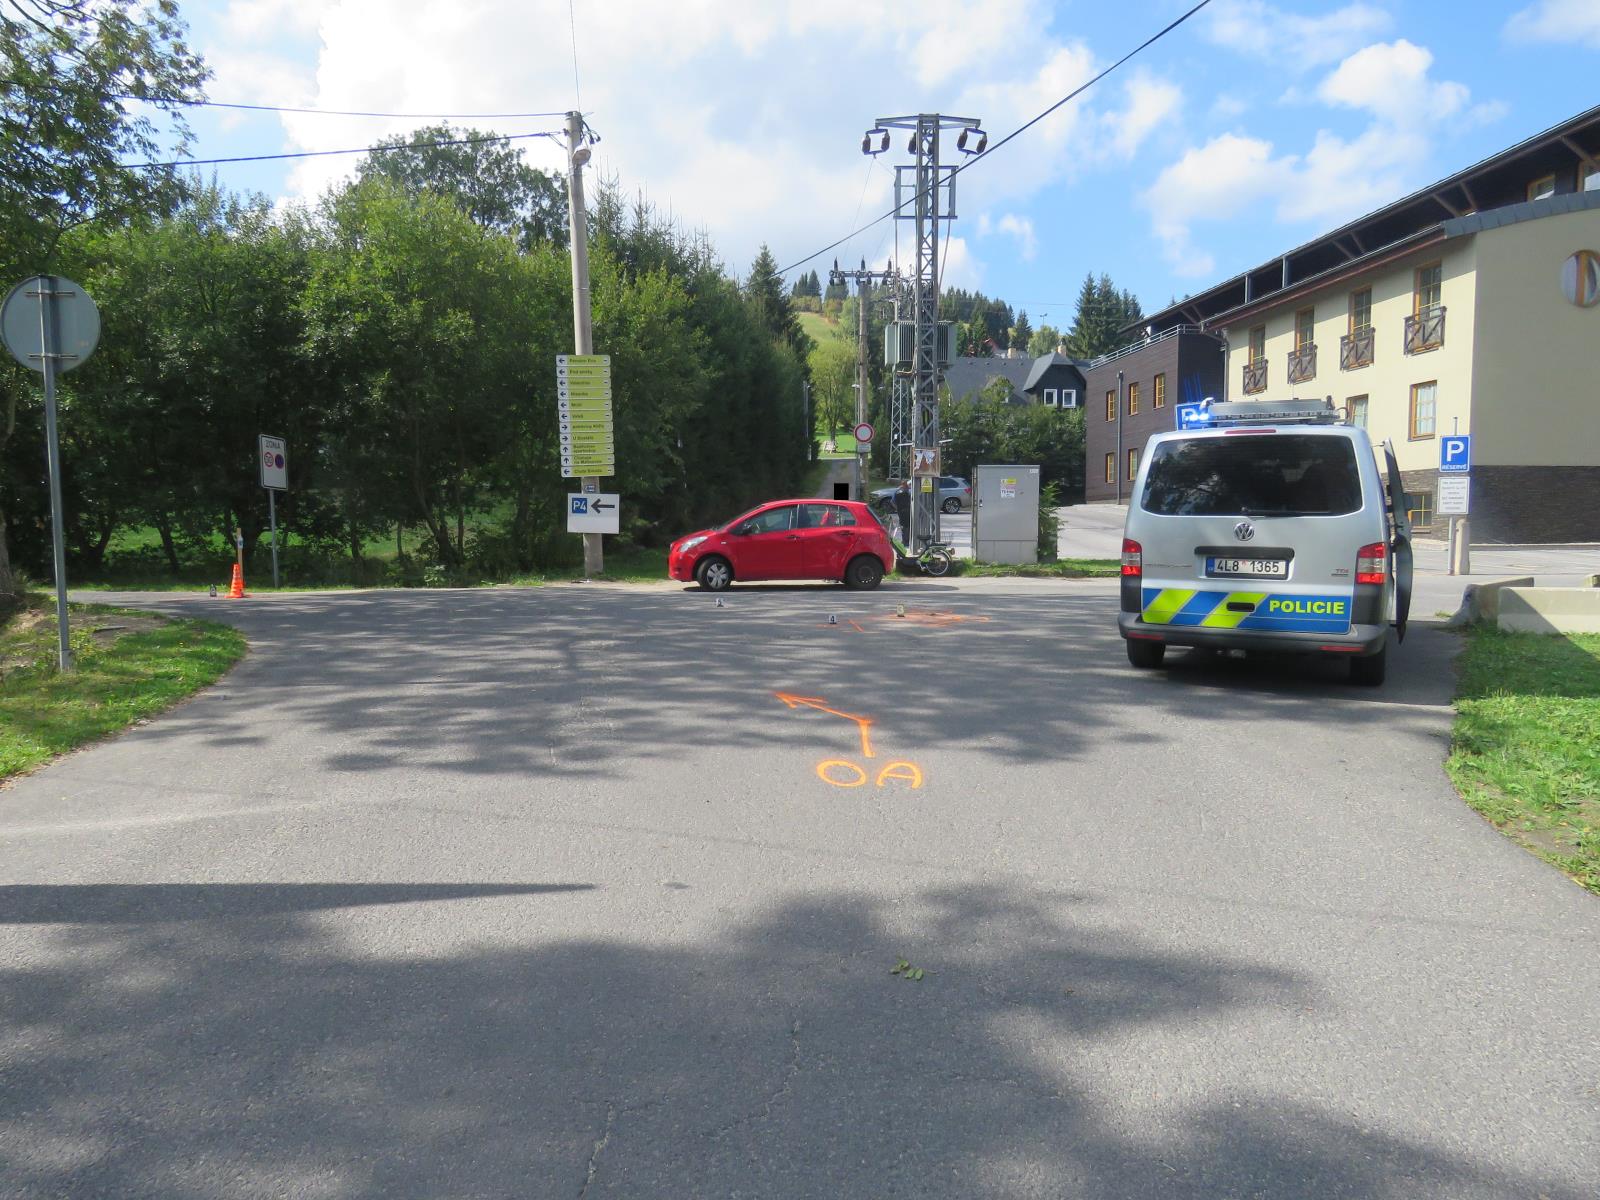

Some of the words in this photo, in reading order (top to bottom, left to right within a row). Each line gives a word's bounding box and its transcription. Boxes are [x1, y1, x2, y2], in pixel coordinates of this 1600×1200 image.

[1446, 440, 1465, 462] P
[573, 500, 587, 511] P4
[1217, 560, 1239, 572] 4L8
[1250, 561, 1279, 573] 1365
[1269, 600, 1345, 614] POLICIE
